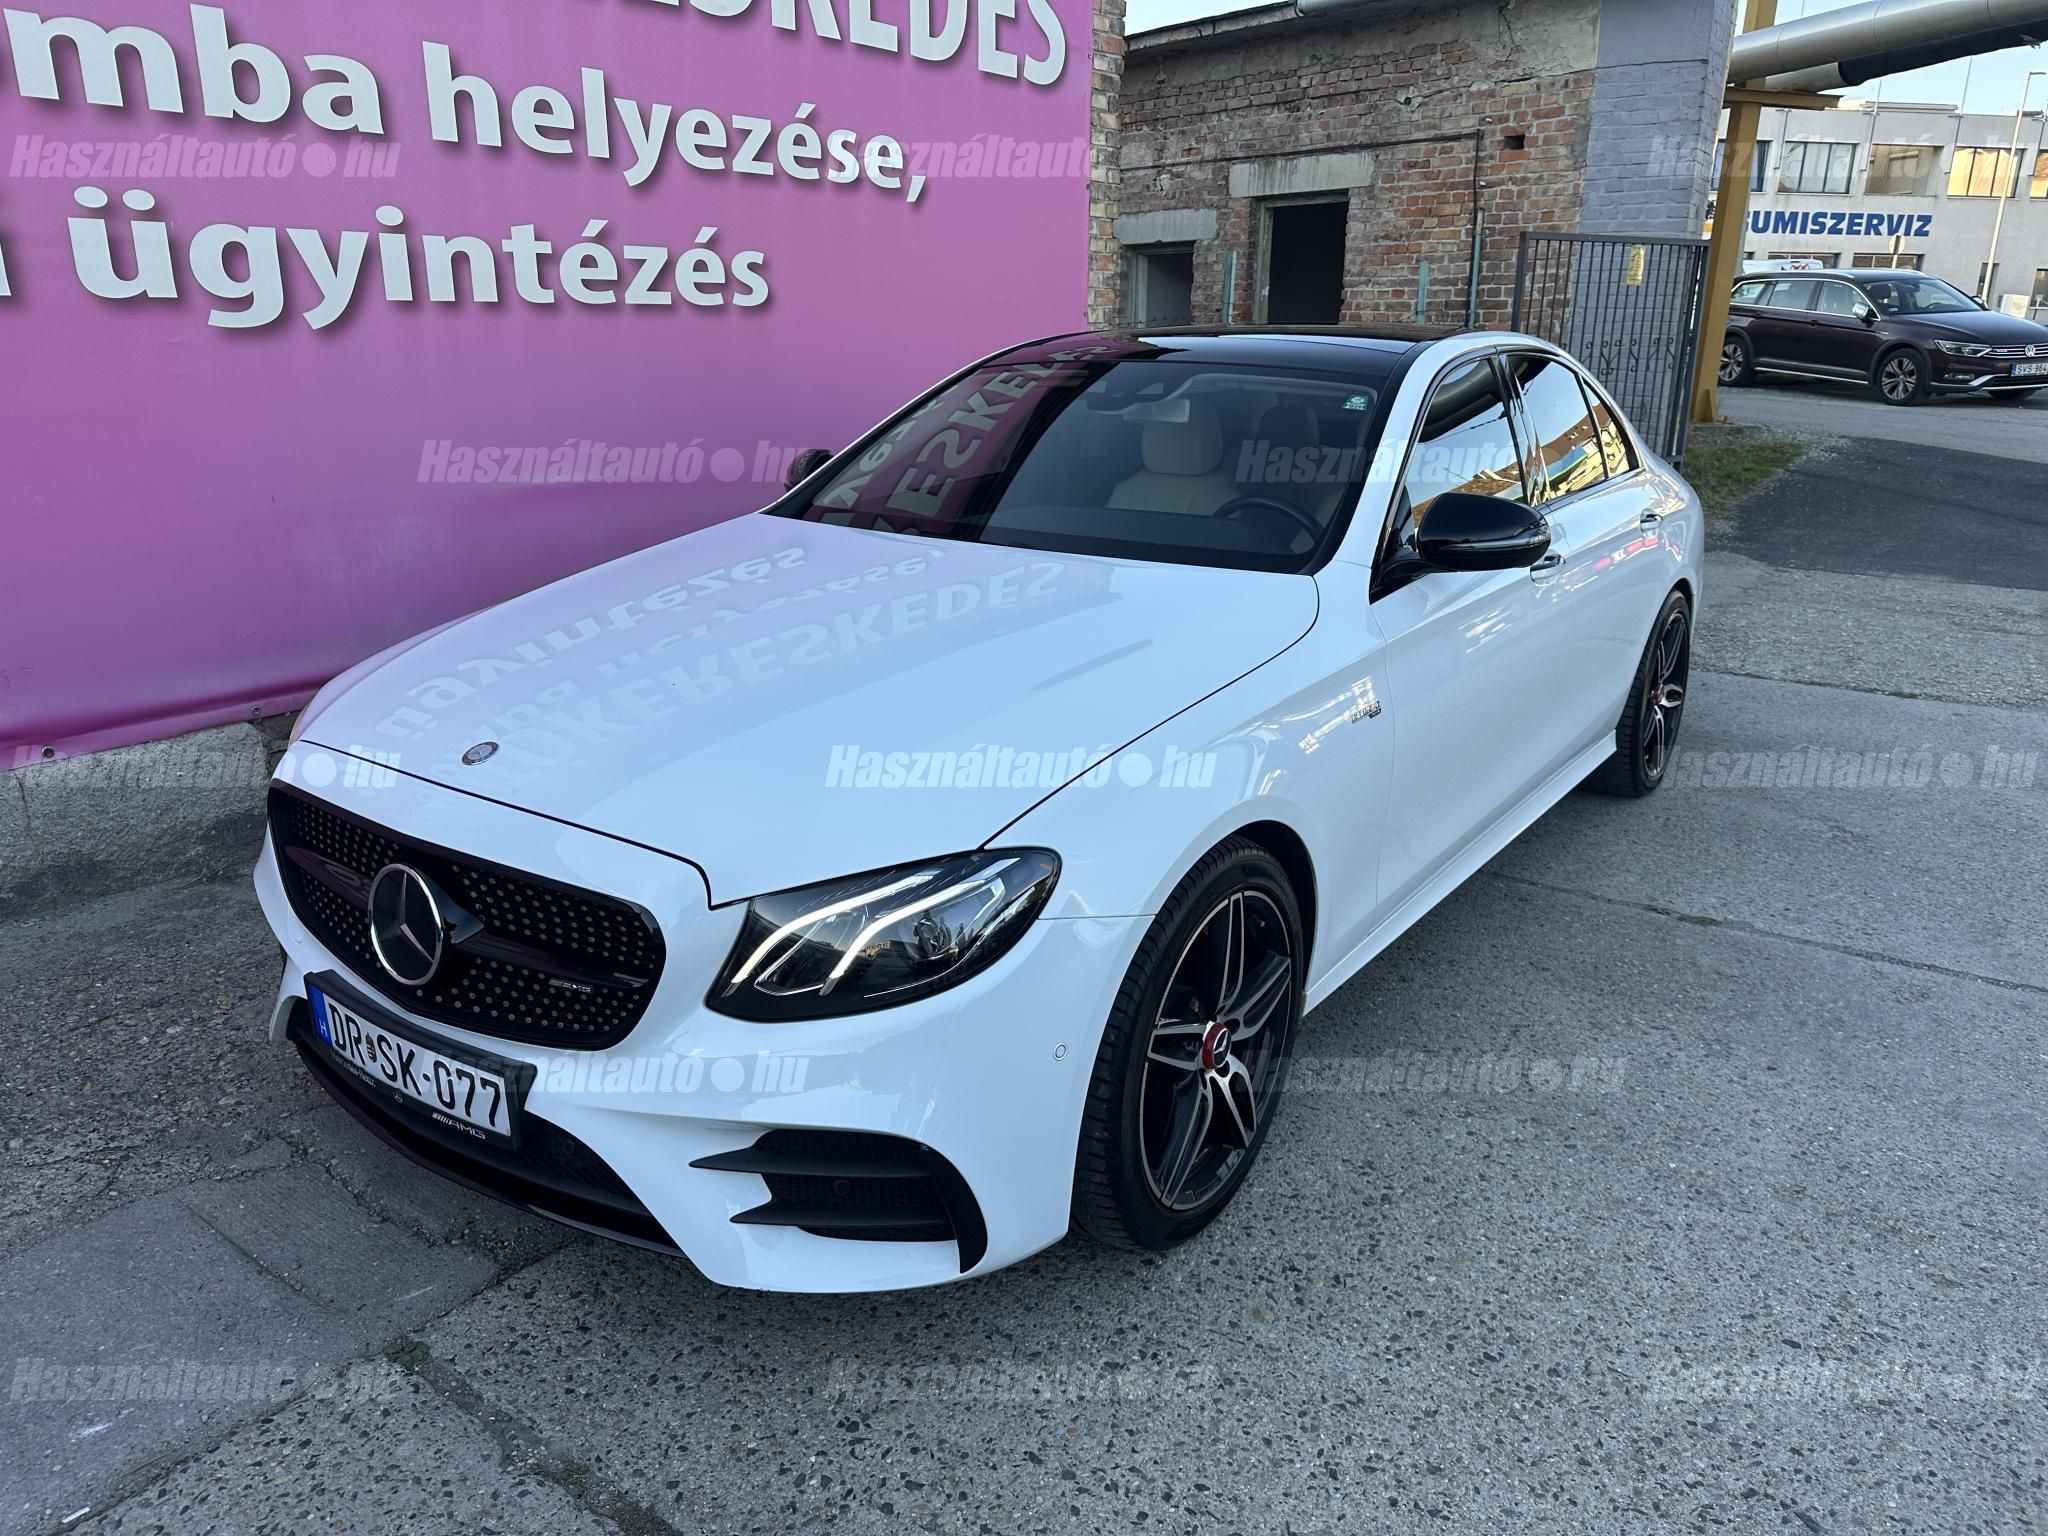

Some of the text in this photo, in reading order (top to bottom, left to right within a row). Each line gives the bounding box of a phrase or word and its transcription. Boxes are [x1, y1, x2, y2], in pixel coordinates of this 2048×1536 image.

[3, 2, 927, 203] mba helyezése,
[67, 185, 770, 330] ügyintézés
[1746, 210, 1933, 238] UMISZERVIZ
[328, 1001, 501, 1128] DR SK-077
[444, 1116, 487, 1140] AMG
